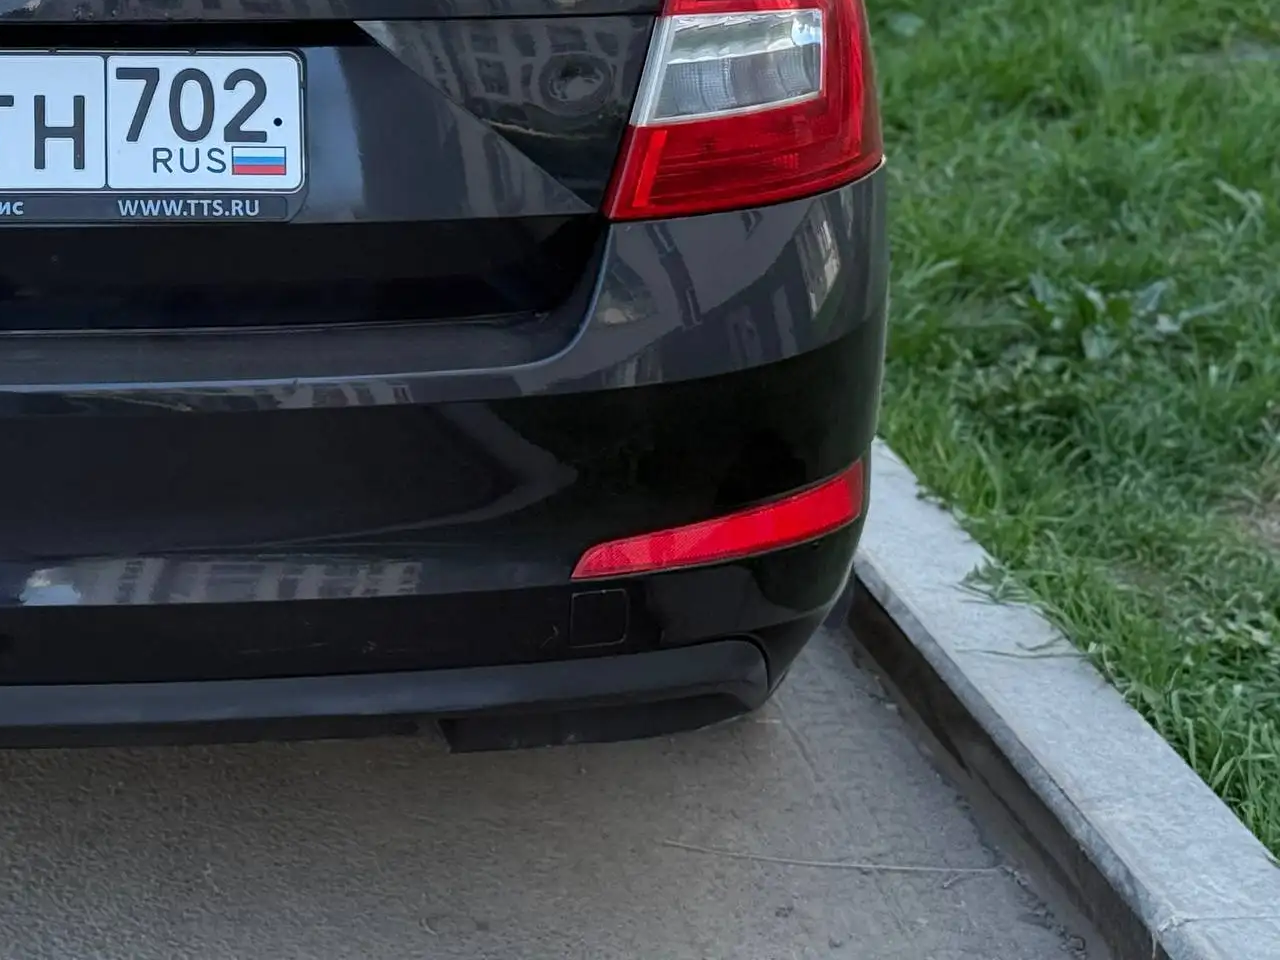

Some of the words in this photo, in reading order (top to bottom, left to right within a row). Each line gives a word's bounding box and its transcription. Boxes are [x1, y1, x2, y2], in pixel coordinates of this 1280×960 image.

[115, 67, 268, 143] 702
[152, 147, 227, 174] RUS
[117, 198, 260, 217] WWW.TTS.RU
